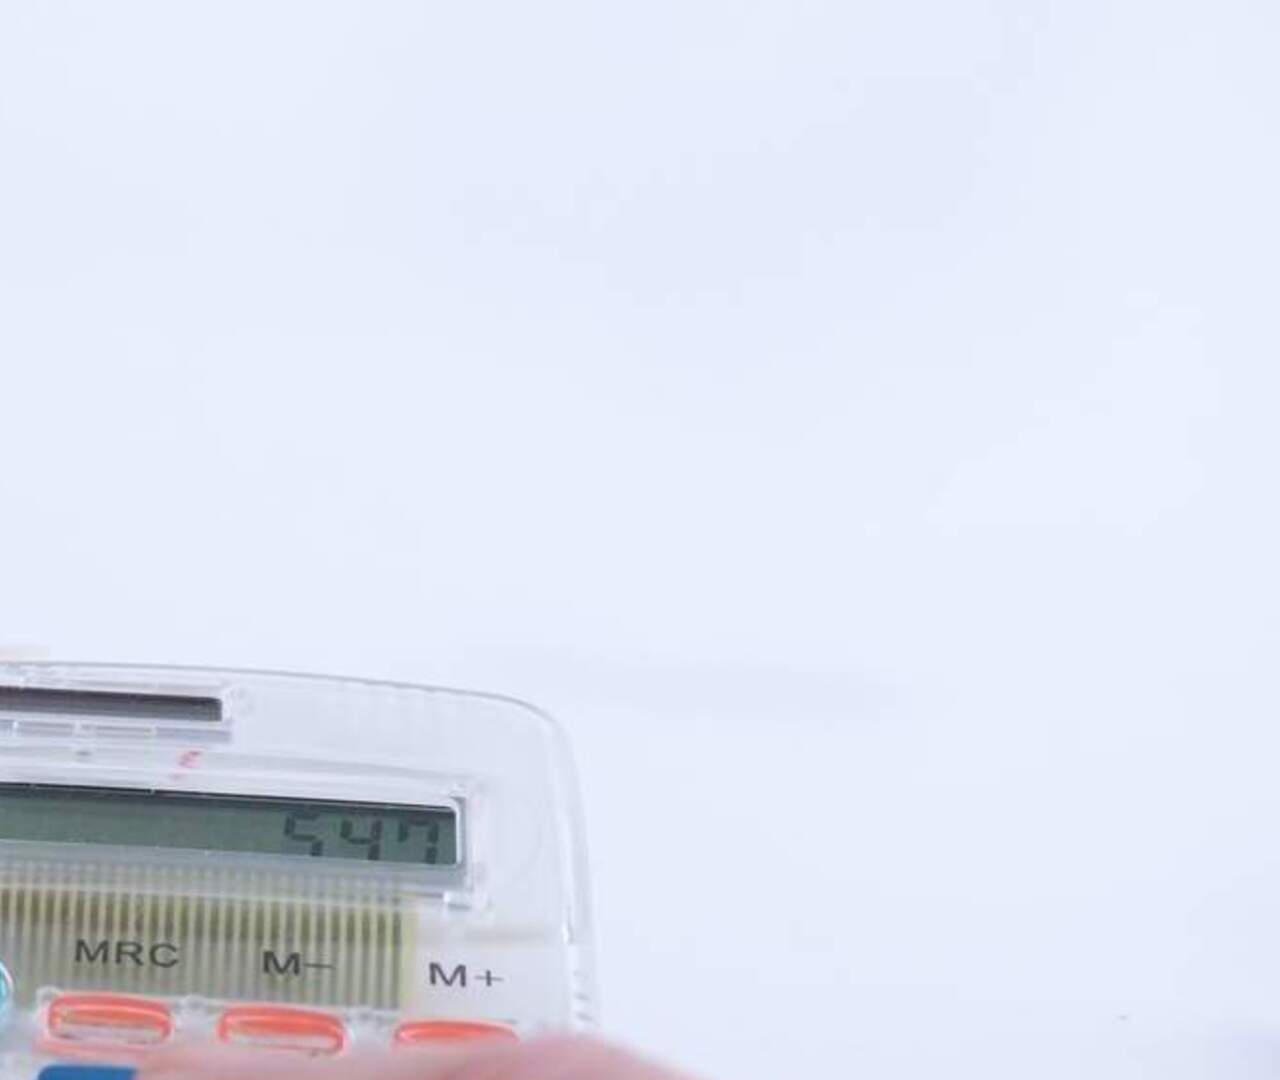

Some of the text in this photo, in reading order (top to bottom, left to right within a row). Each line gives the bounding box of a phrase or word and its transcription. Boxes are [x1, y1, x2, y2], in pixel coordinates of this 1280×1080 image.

[284, 806, 438, 864] 547
[75, 939, 179, 968] MRC
[429, 962, 505, 987] M+
